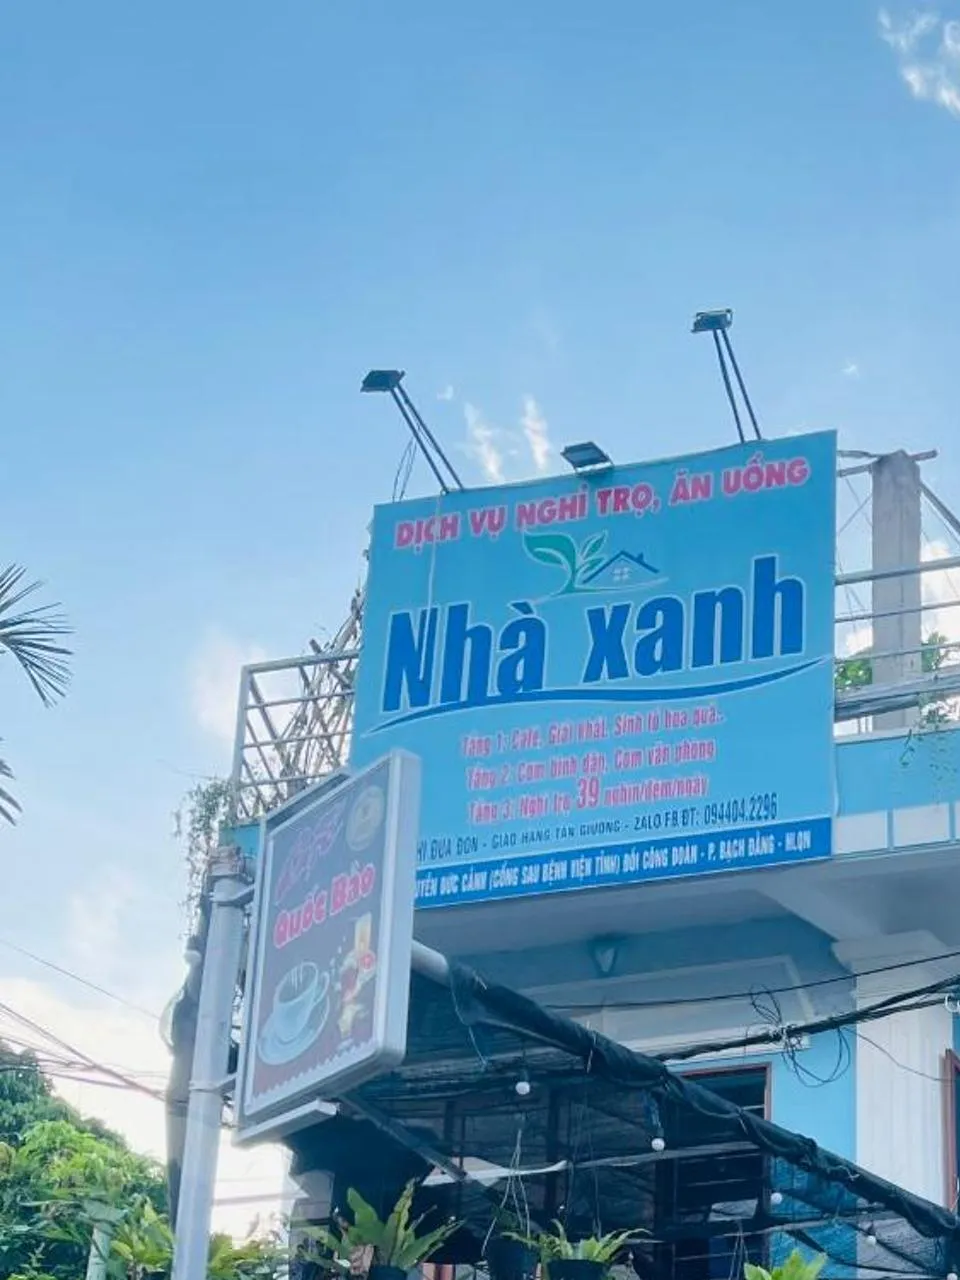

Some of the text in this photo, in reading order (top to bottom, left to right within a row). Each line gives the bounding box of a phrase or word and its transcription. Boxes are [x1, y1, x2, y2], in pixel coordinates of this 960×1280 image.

[395, 512, 460, 554] DỊCH
[469, 505, 508, 540] VỤ
[515, 482, 590, 531] NGHỈ
[669, 468, 714, 506] ĂN
[722, 451, 811, 496] UỐNG
[381, 554, 806, 712] Nhà xanh
[576, 775, 601, 810] 39
[719, 838, 746, 863] BẠCH
